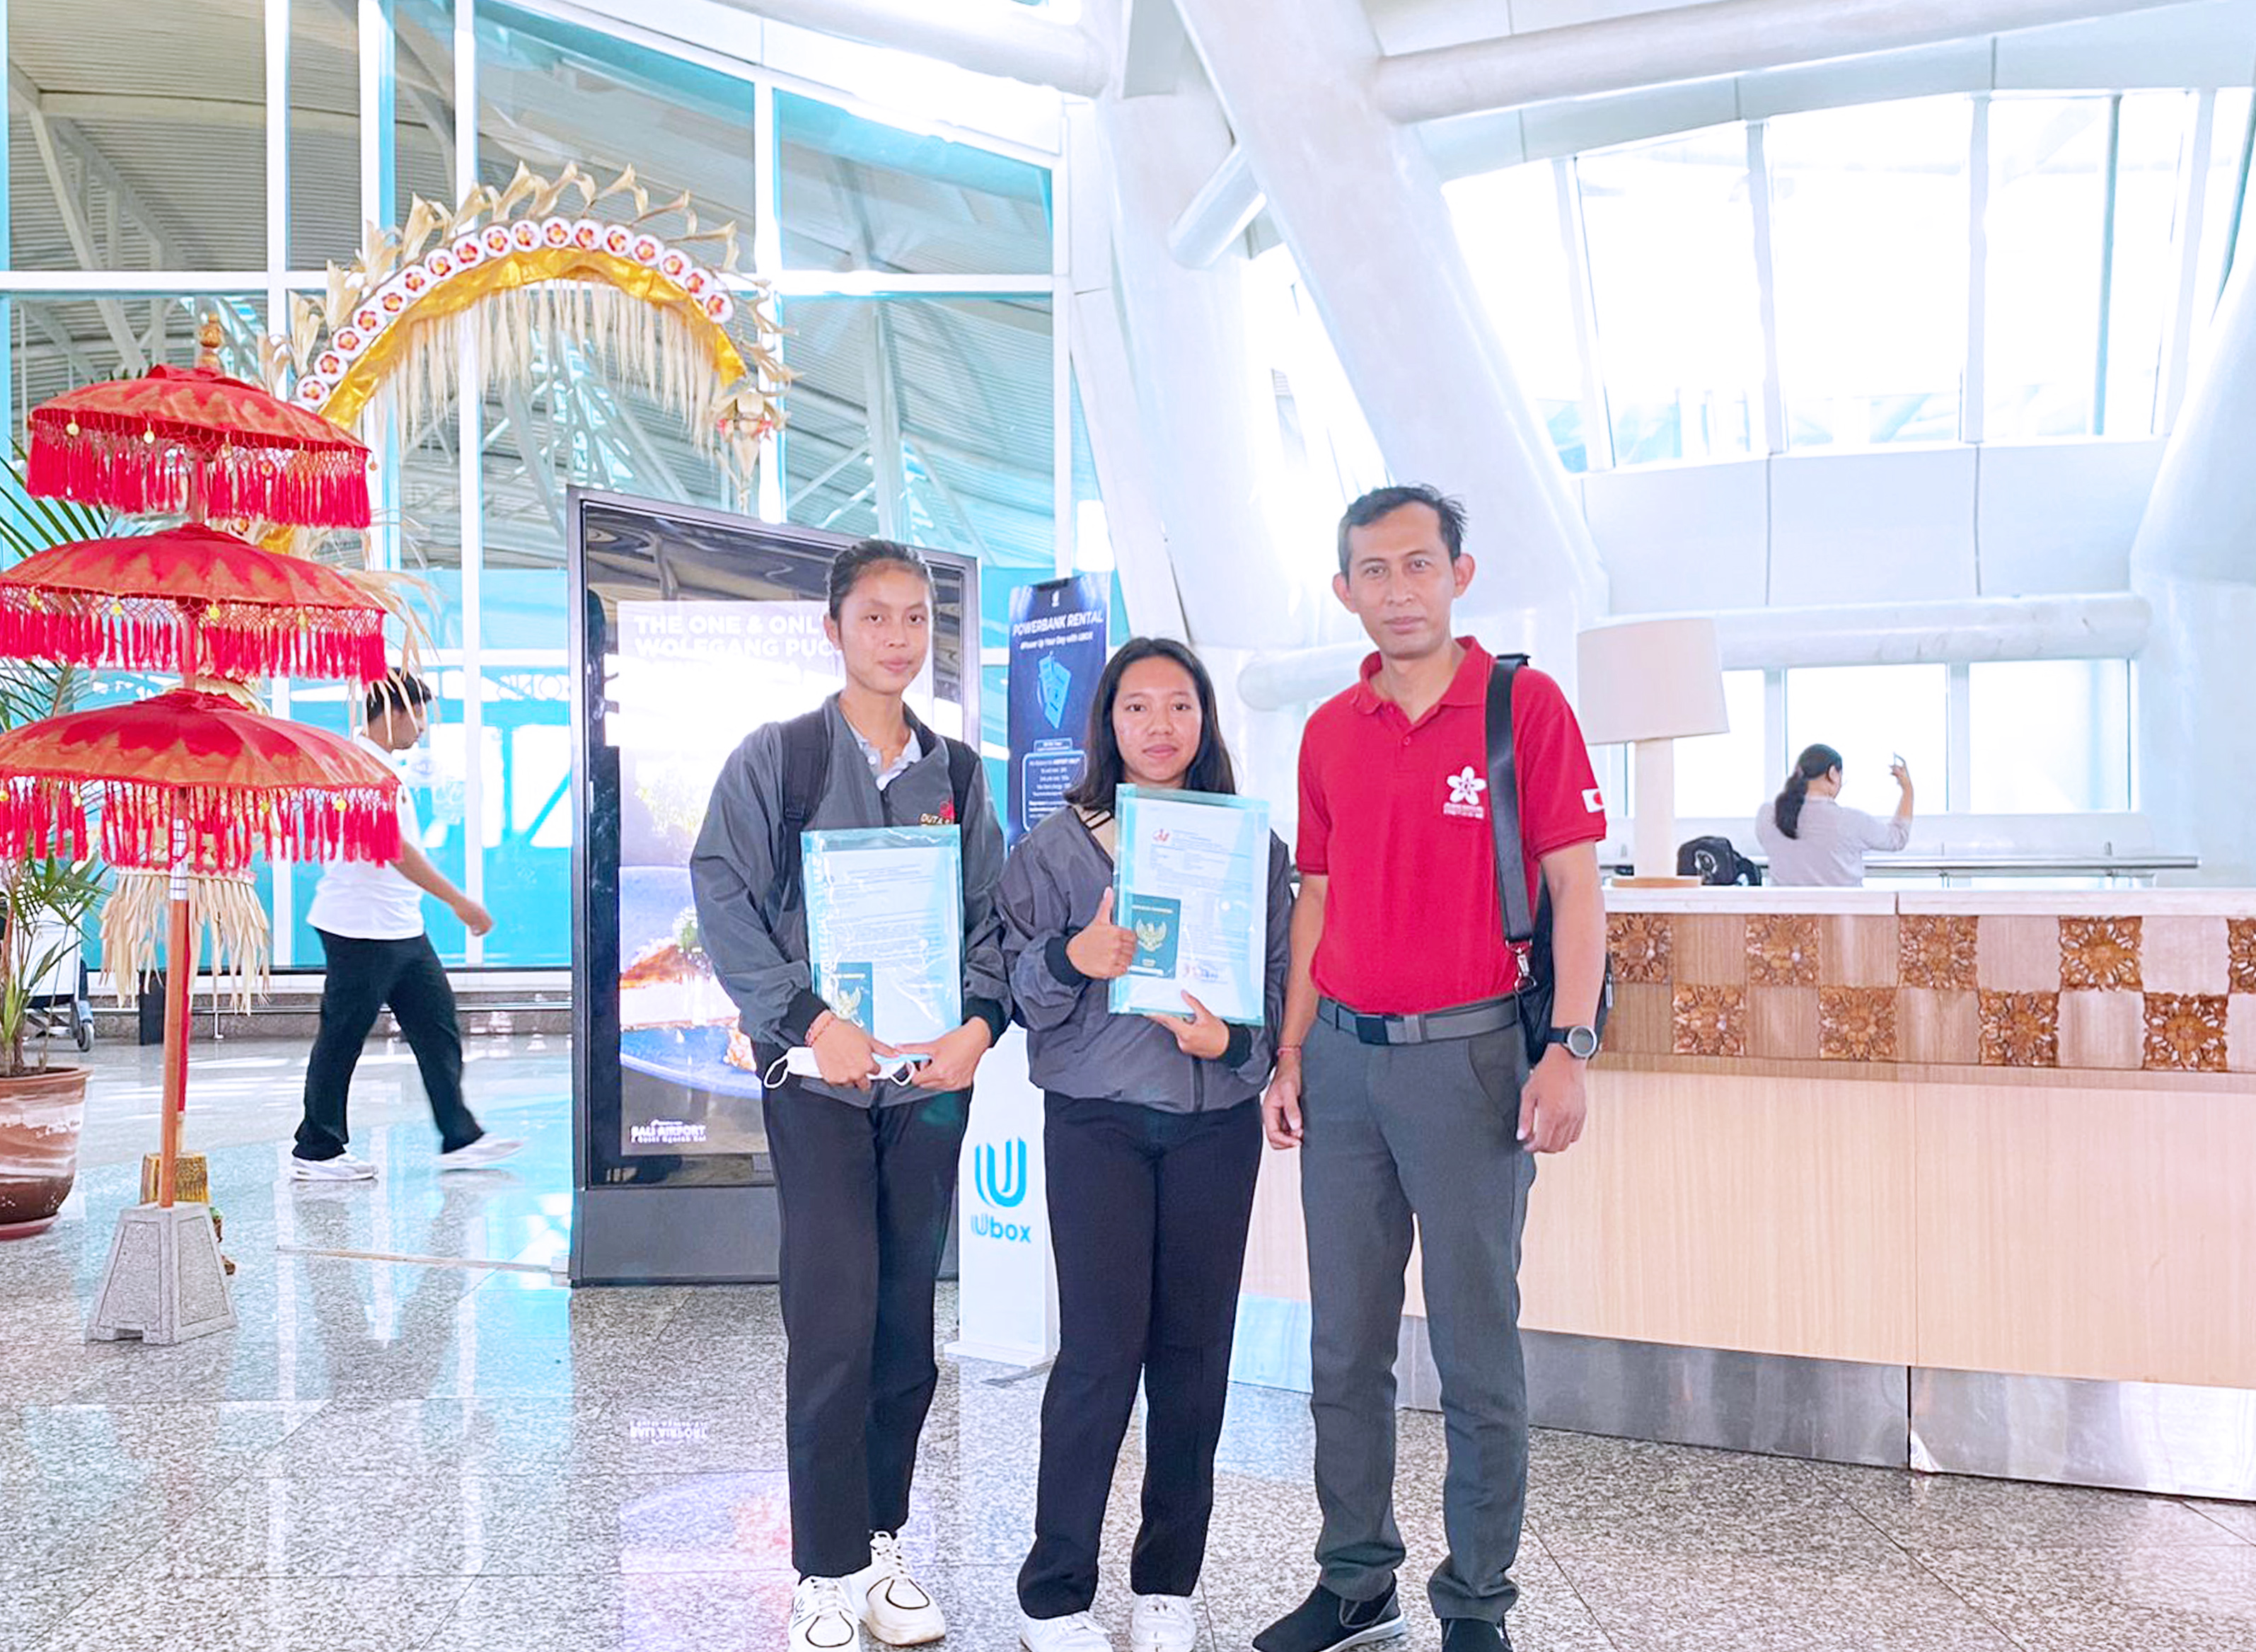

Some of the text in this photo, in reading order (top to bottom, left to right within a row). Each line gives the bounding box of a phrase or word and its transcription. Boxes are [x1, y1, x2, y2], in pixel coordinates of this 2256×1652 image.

[634, 615, 823, 635] THE ONE & ONL
[1012, 610, 1104, 636] POWERBANK RENTAL
[635, 637, 835, 658] WOLFGANG PUC
[631, 1124, 706, 1136] BALI AIRPORT
[971, 1213, 1031, 1243] Ubox
